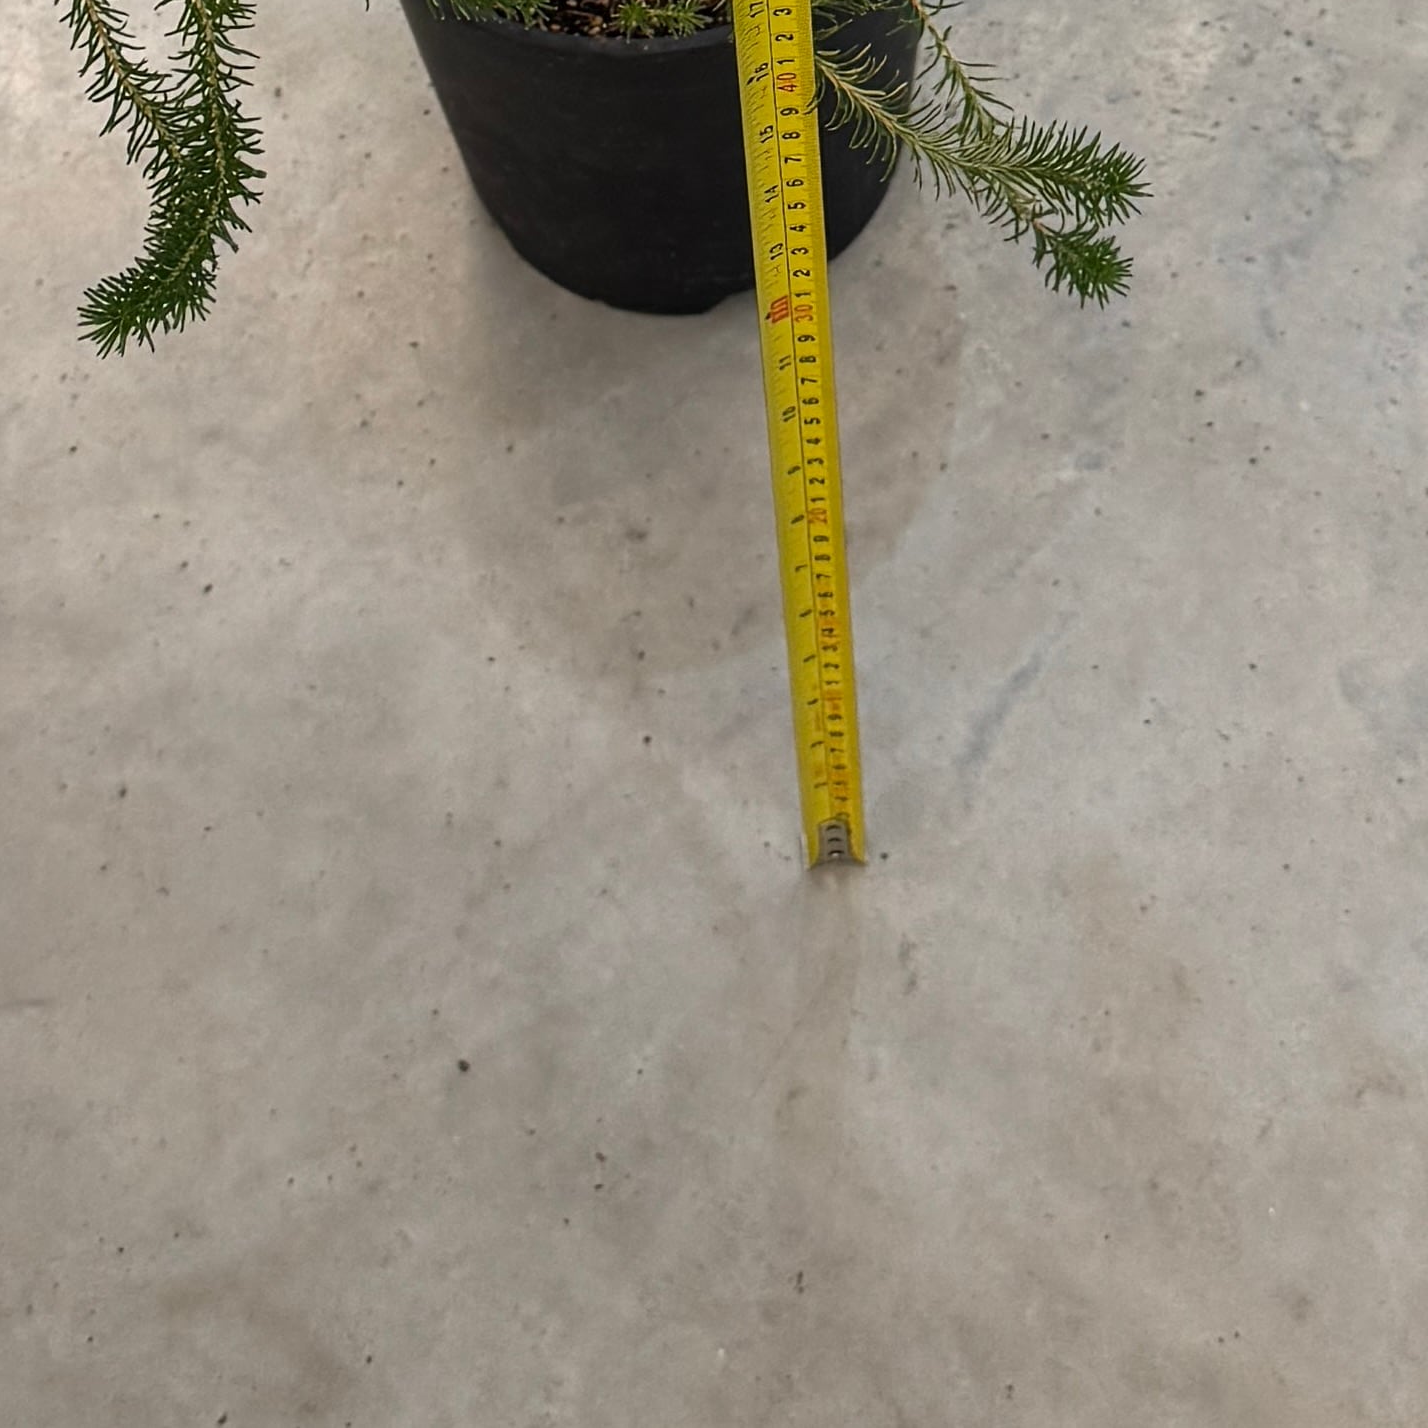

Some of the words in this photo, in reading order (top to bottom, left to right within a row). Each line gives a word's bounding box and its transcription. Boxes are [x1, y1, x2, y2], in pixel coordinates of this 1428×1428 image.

[746, 1, 765, 19] 17
[772, 7, 792, 17] 3
[774, 33, 794, 42] 2
[776, 58, 795, 66] 1
[776, 71, 798, 94] 40
[779, 106, 799, 117] 9
[758, 124, 774, 144] 15
[781, 130, 801, 141] 8
[783, 155, 802, 165] 7
[785, 178, 804, 188] 6
[787, 201, 806, 211] 5
[789, 224, 807, 233] 4
[790, 246, 809, 256] 3
[792, 268, 811, 278] 2
[793, 291, 812, 299] 1
